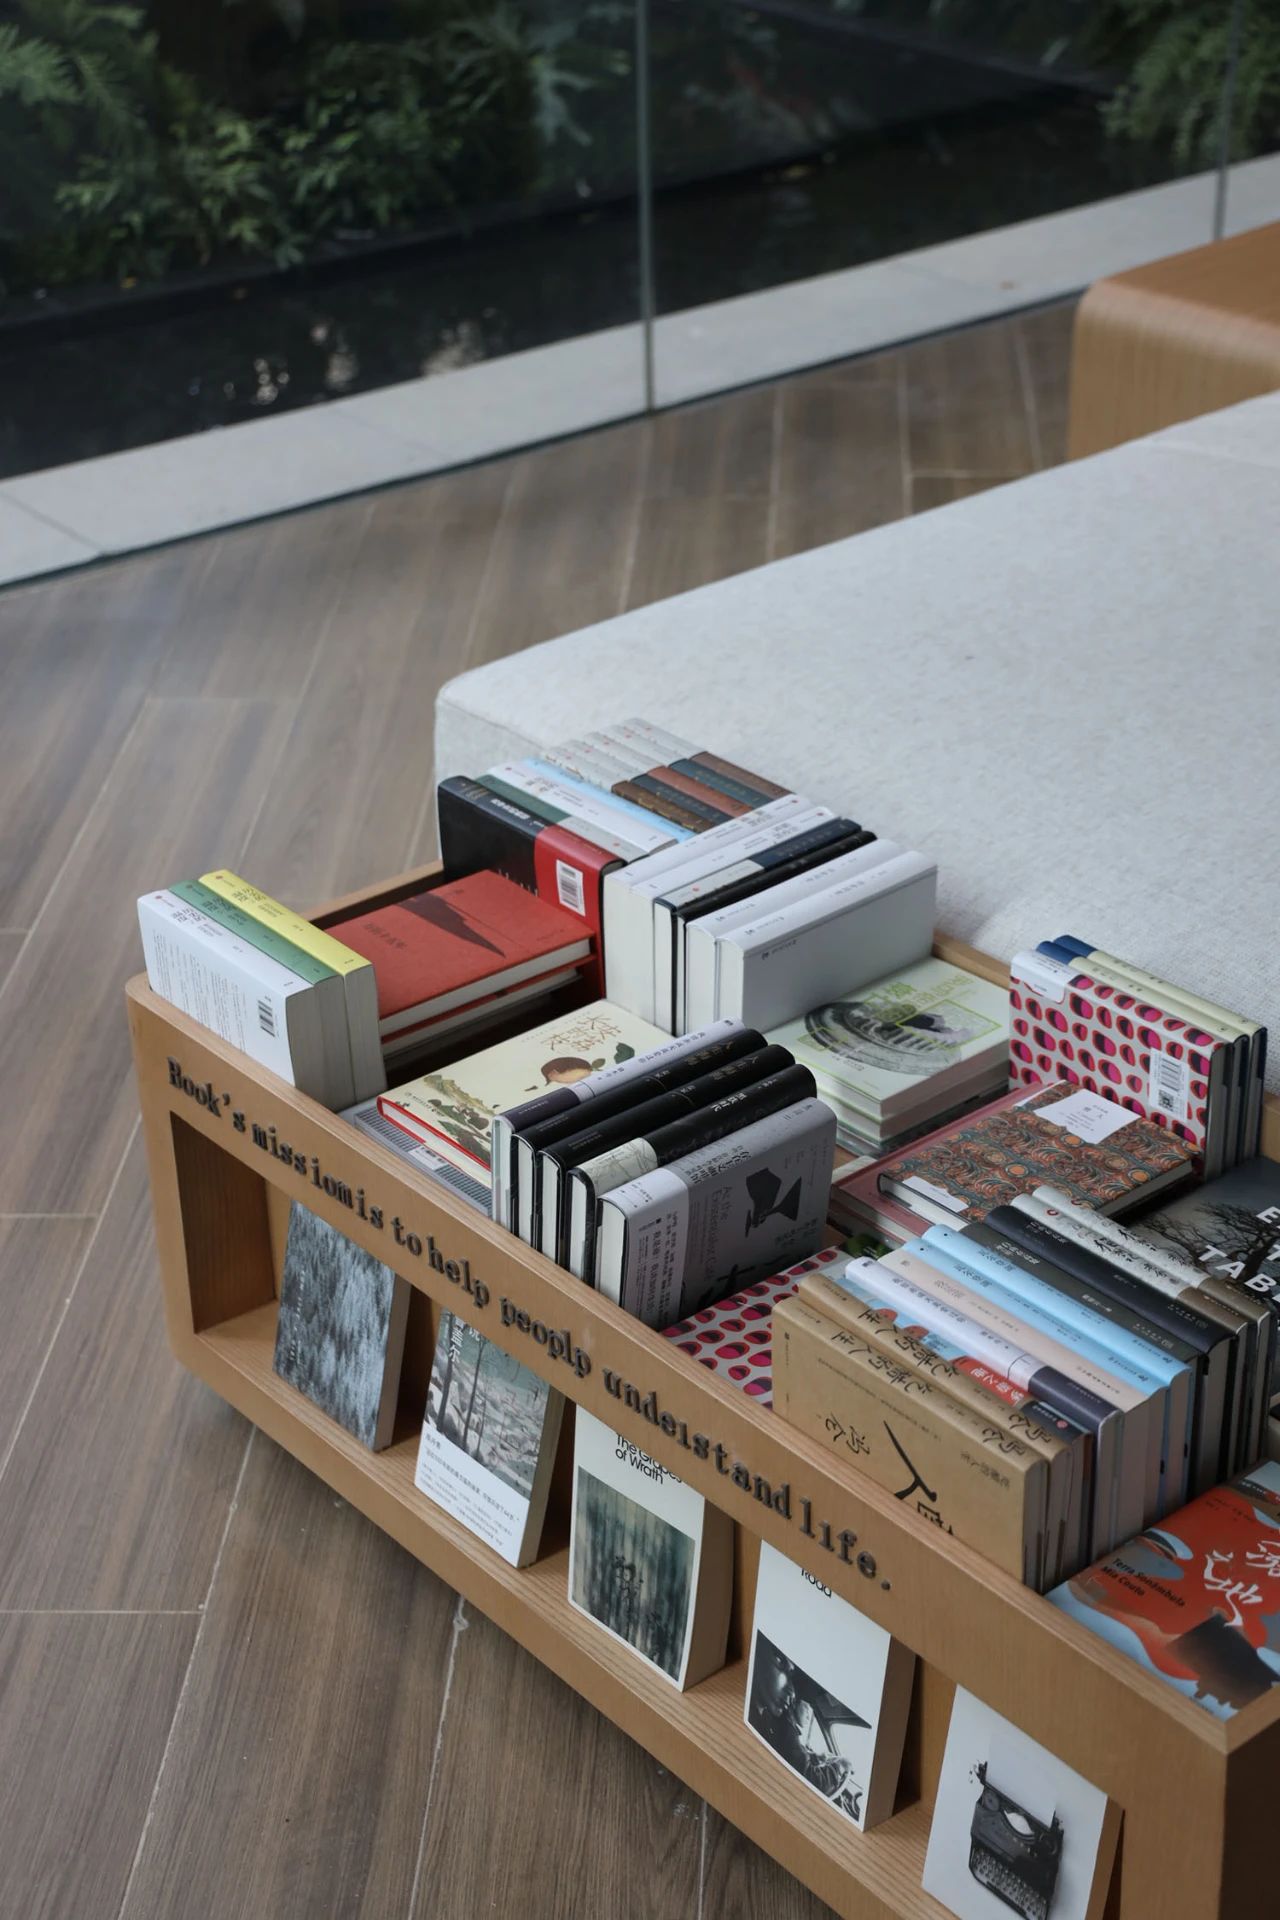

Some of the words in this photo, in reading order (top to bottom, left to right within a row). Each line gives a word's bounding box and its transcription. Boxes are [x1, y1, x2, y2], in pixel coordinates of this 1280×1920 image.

[391, 1214, 423, 1257] to
[426, 1233, 490, 1309] help
[615, 1433, 637, 1457] The
[614, 1448, 628, 1463] of
[628, 1453, 664, 1485] Wrath
[1112, 1557, 1135, 1576] Terra
[1120, 1574, 1146, 1598] Couto
